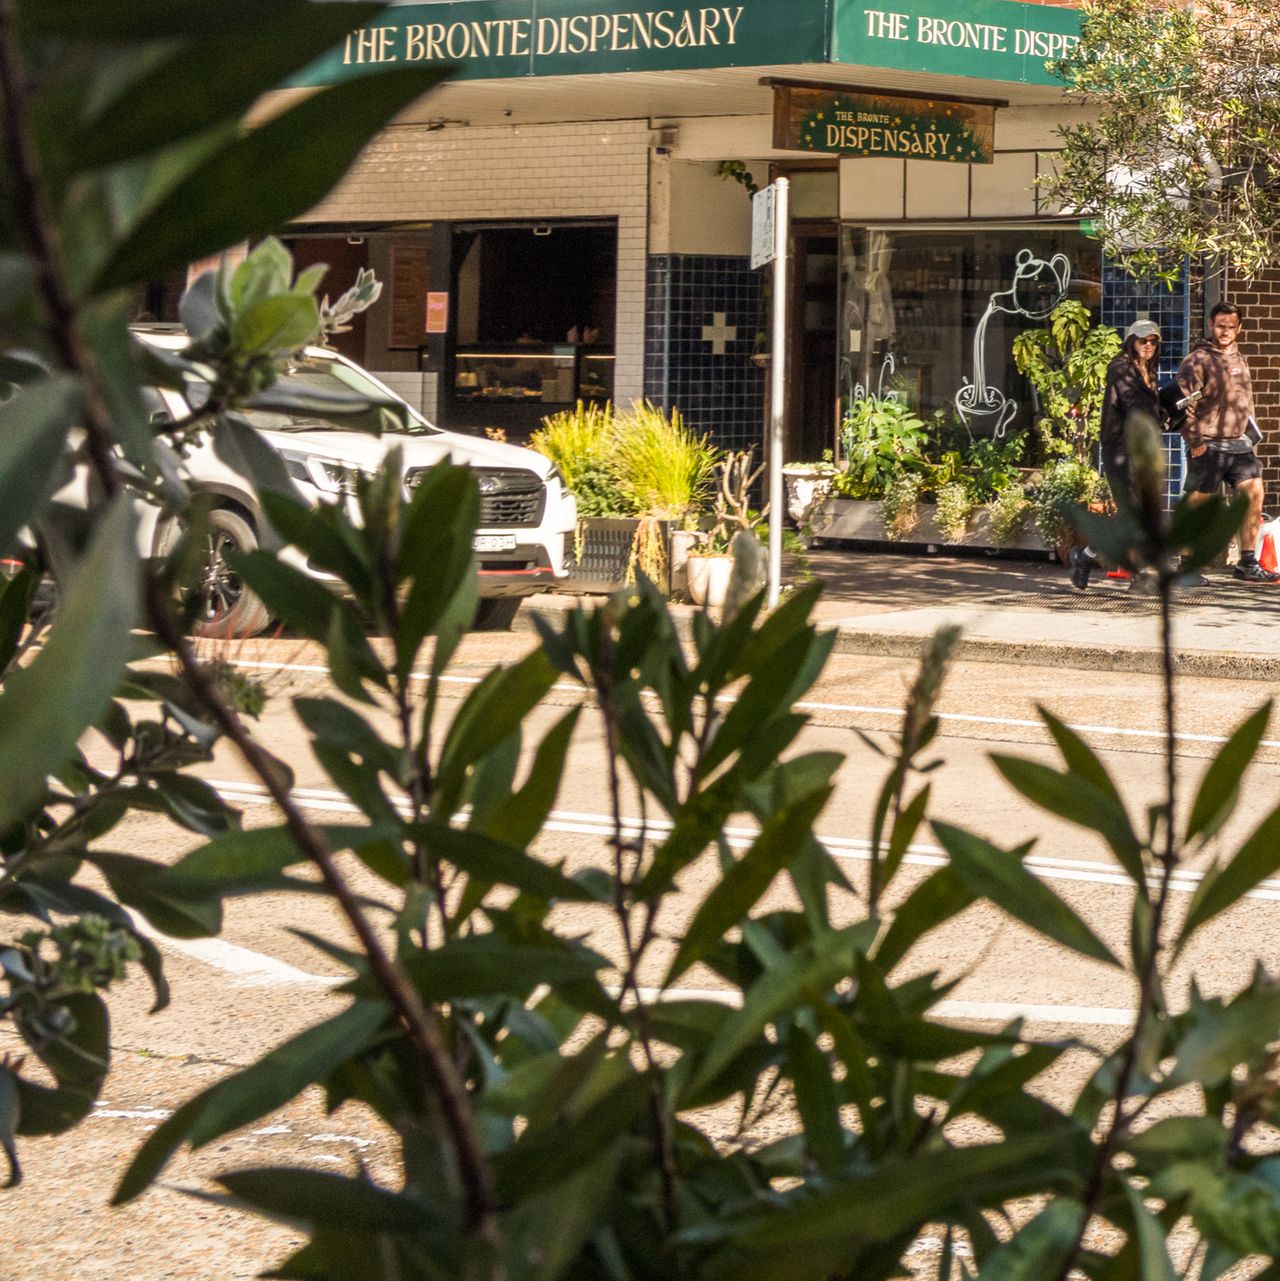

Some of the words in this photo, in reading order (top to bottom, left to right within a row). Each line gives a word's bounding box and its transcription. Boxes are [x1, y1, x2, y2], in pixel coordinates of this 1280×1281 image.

[343, 26, 398, 65] THE
[404, 18, 531, 62] BRONTE
[535, 6, 745, 57] DISPENSARY
[864, 10, 909, 41] THE
[917, 16, 1007, 52] BRONTE
[835, 111, 853, 121] THE
[857, 113, 890, 124] BRONTE
[825, 124, 950, 155] DISPENSARY
